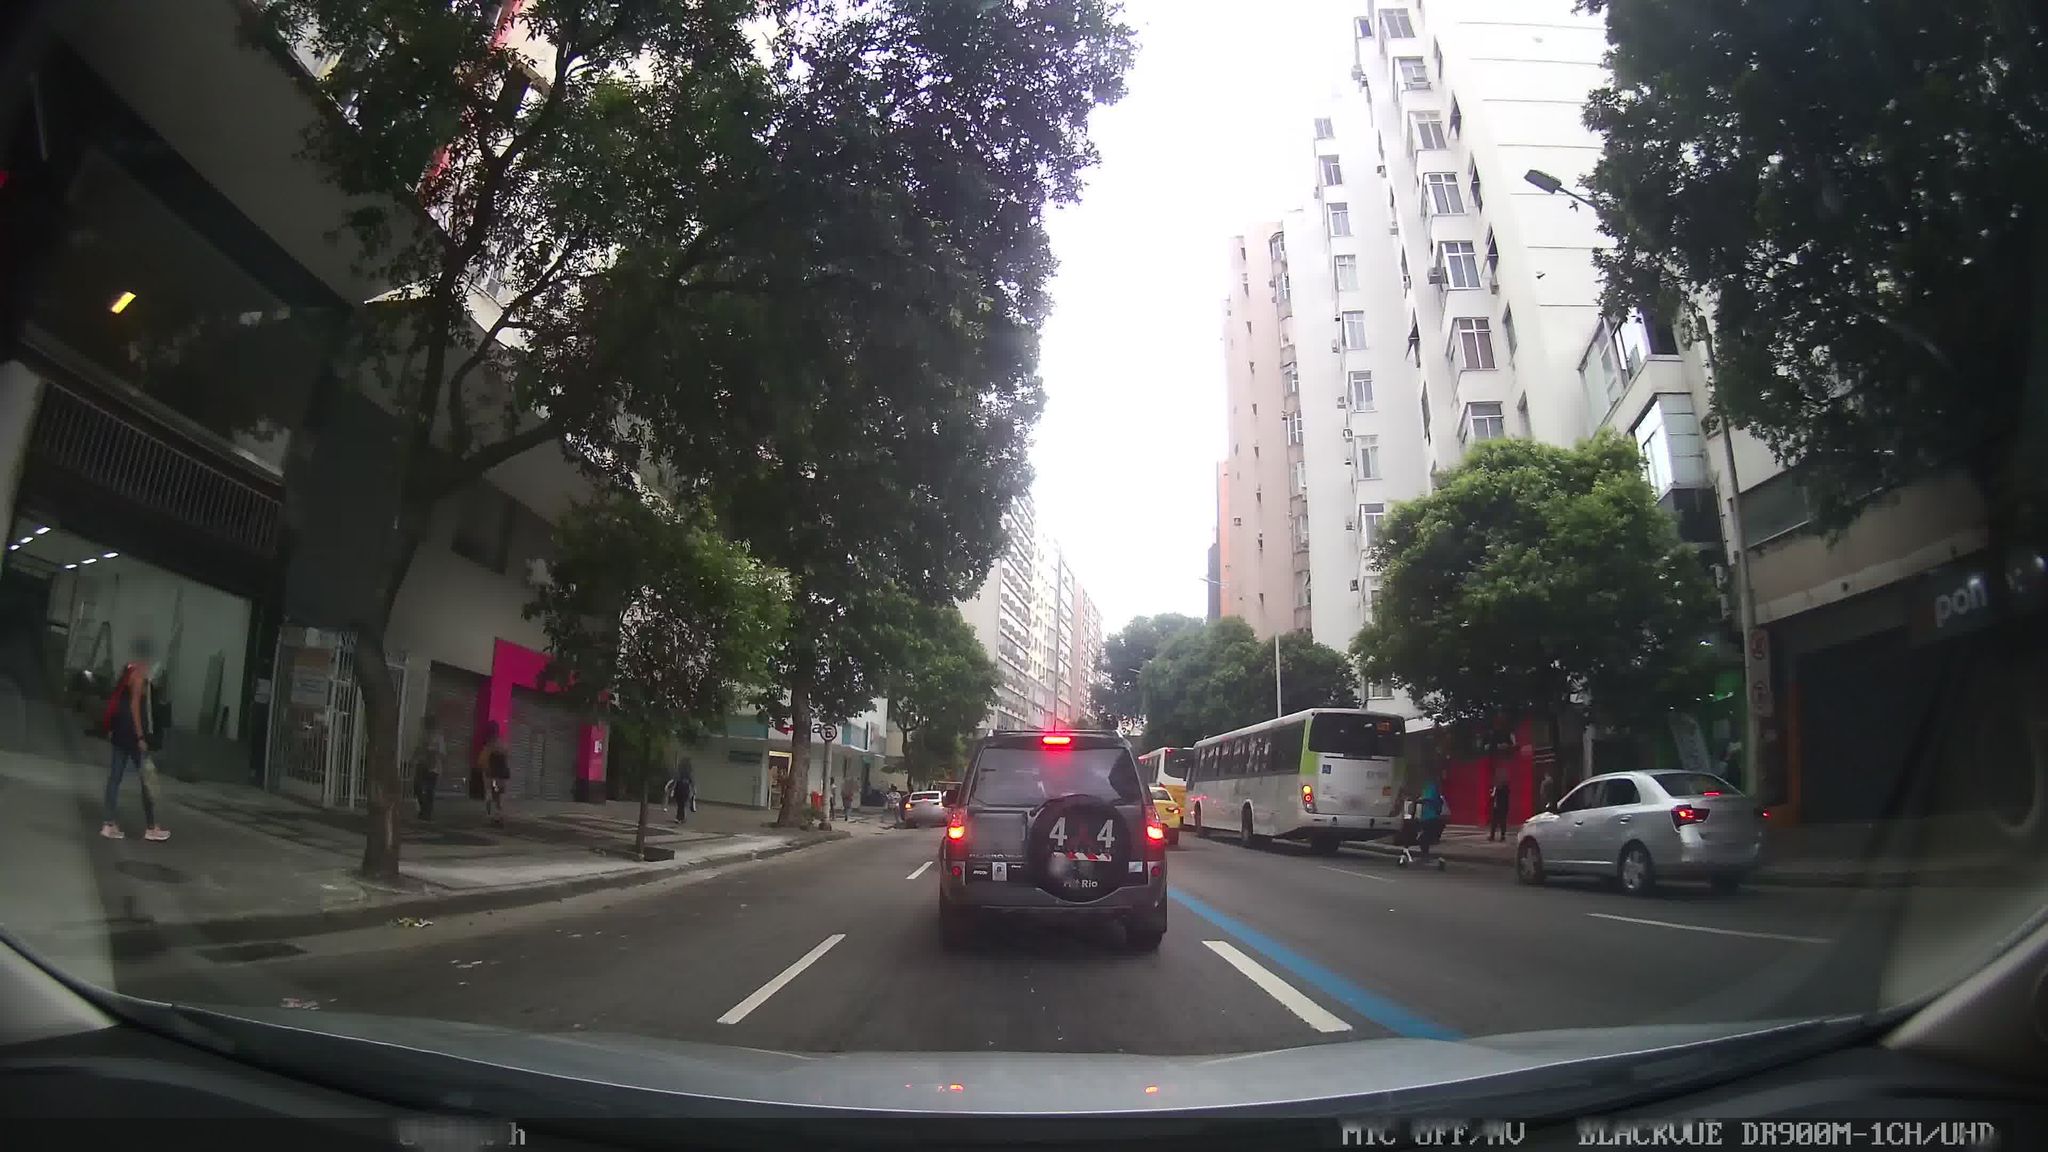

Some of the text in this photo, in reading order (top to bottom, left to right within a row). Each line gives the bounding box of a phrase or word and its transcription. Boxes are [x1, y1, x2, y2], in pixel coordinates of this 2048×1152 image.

[1048, 816, 1116, 849] 4 4
[1081, 879, 1099, 888] Rio
